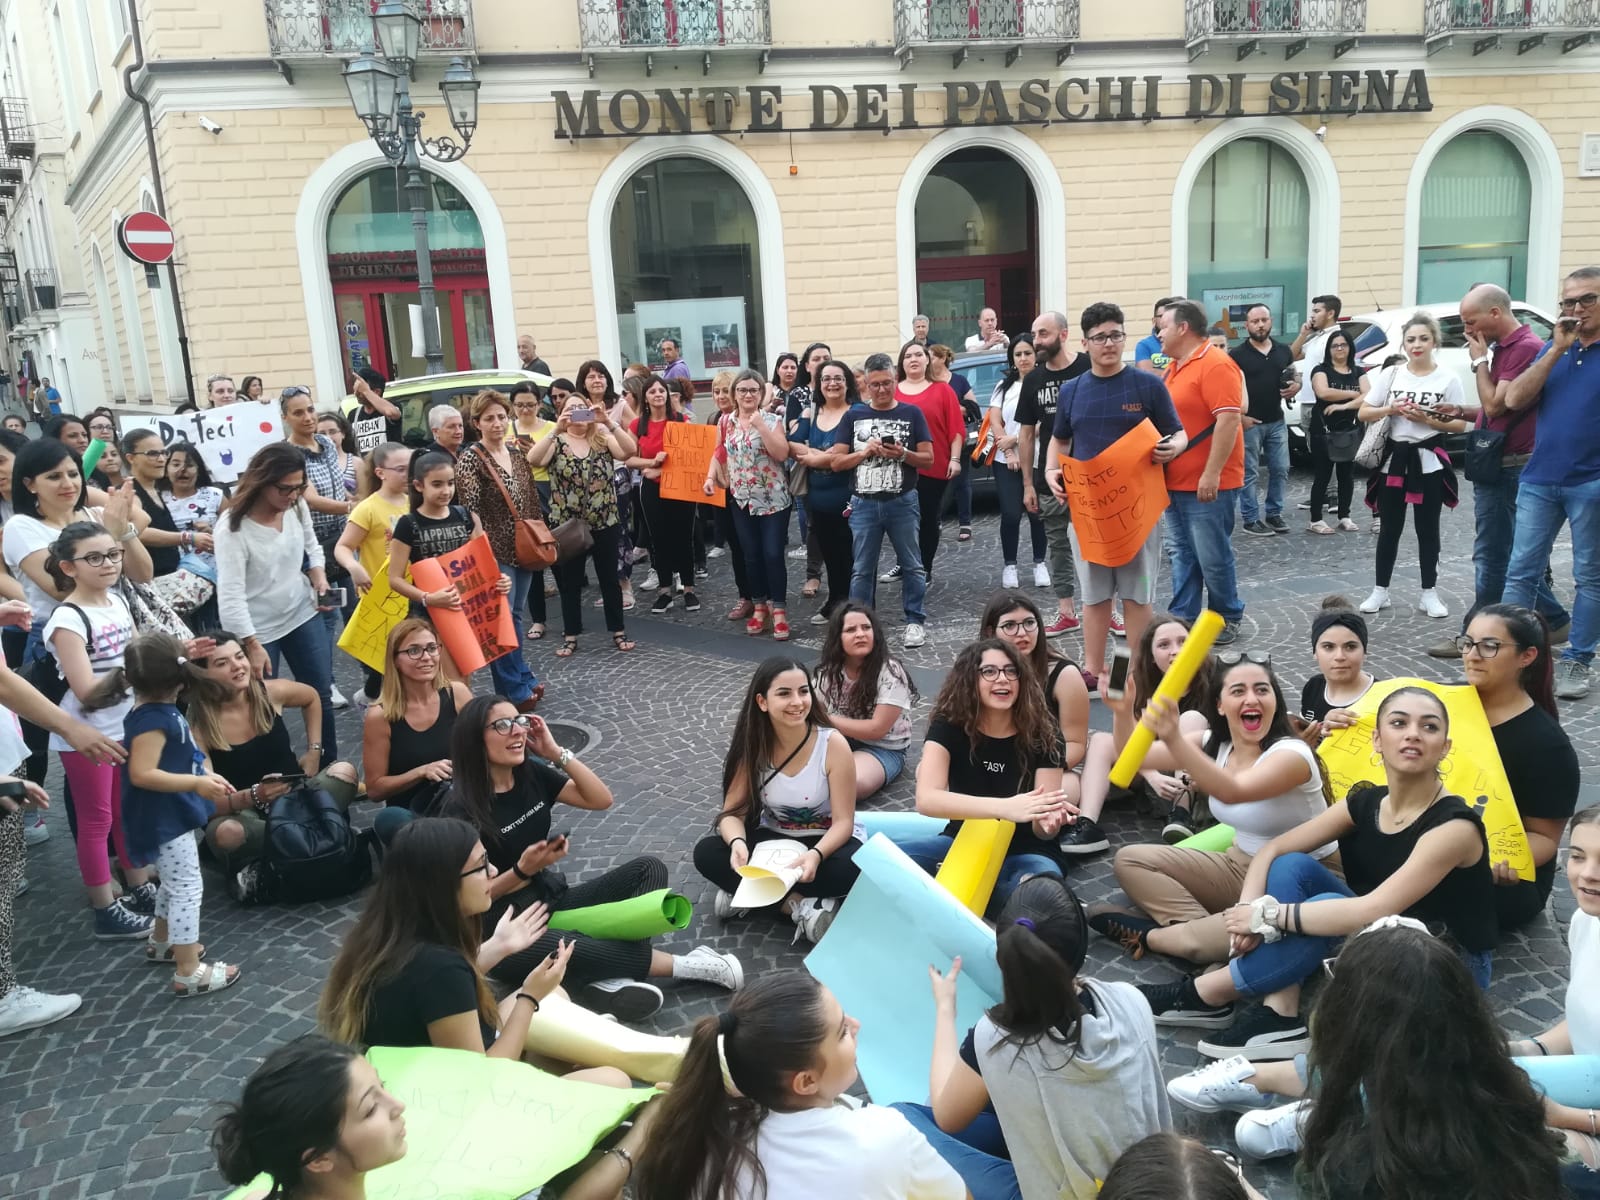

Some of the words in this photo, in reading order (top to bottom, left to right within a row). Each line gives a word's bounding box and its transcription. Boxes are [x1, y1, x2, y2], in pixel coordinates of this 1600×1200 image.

[551, 85, 783, 136] MONTE
[808, 83, 919, 131] DEI
[943, 75, 1162, 126] PASCHI
[1186, 73, 1246, 118] DI
[1268, 69, 1433, 114] SIENA
[359, 264, 403, 276] SIENA
